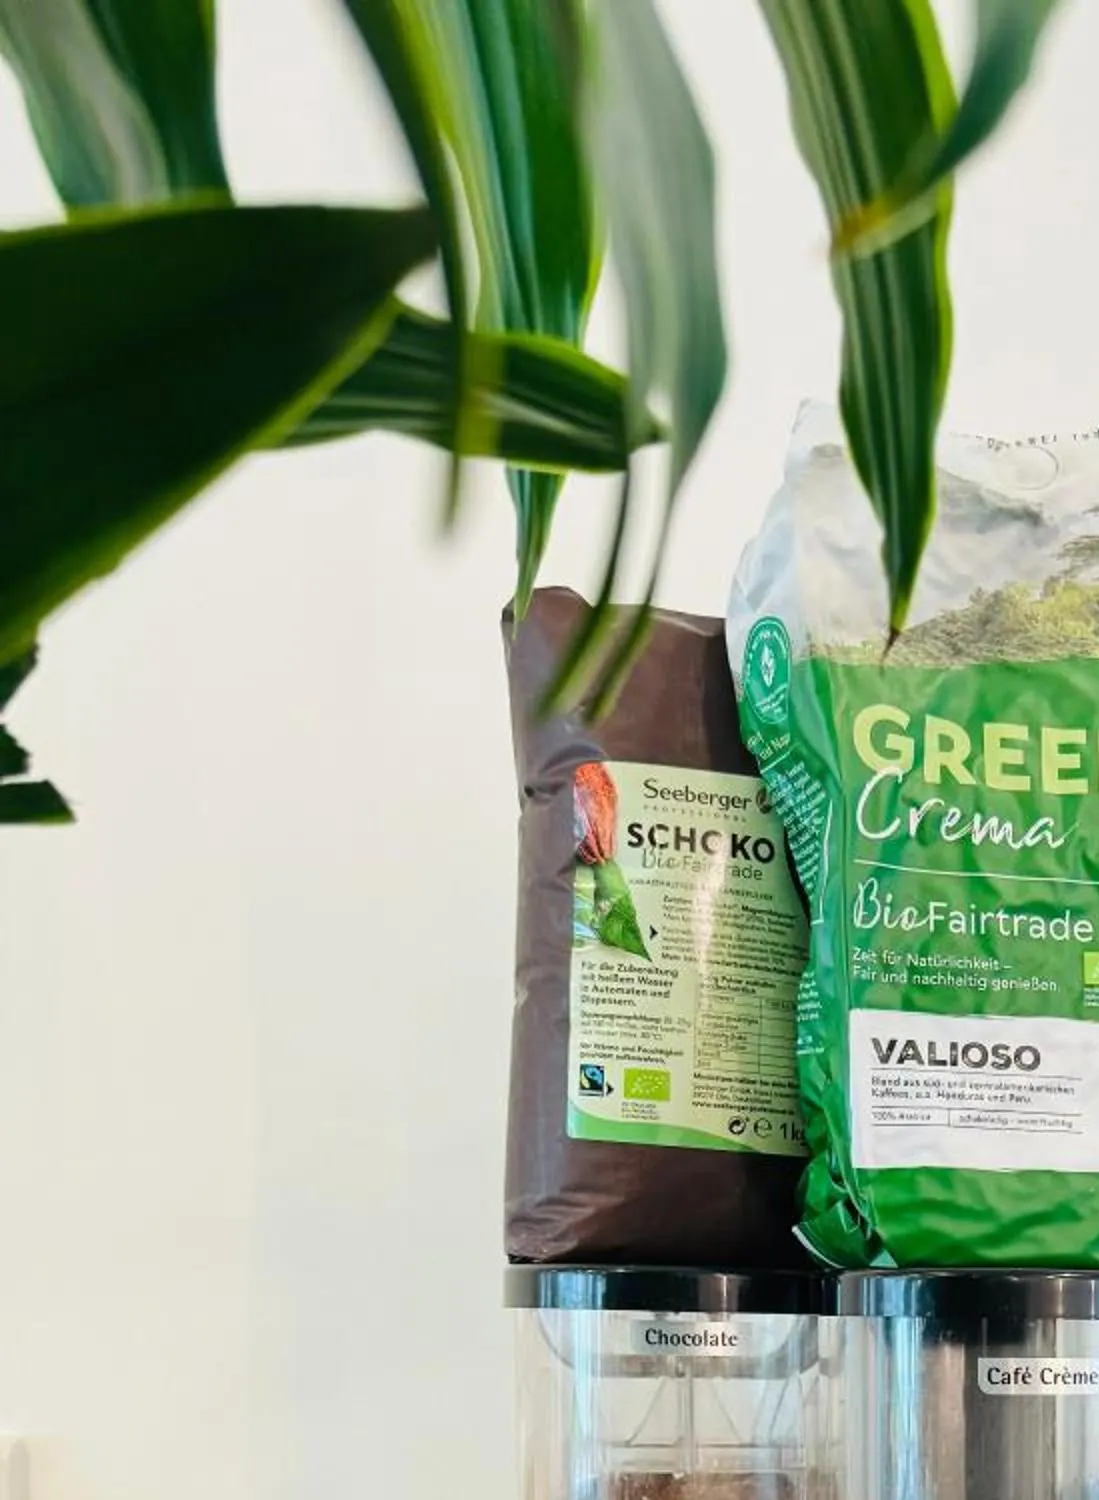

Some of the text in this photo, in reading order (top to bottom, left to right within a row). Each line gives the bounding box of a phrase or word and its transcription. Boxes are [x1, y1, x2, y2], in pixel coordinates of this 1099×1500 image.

[643, 778, 753, 811] Seeberger
[856, 766, 1076, 850] Crema
[627, 823, 775, 863] SCHOKO
[852, 947, 877, 964] Zeit
[882, 950, 901, 965] für
[907, 953, 1000, 971] Natürlichkeit
[853, 965, 877, 981] Fair
[881, 970, 908, 984] und
[912, 972, 987, 991] nachhaltig
[871, 1037, 1041, 1072] VALIOSO
[645, 1328, 739, 1347] Chocolate
[987, 1366, 1099, 1385] Café Crème
